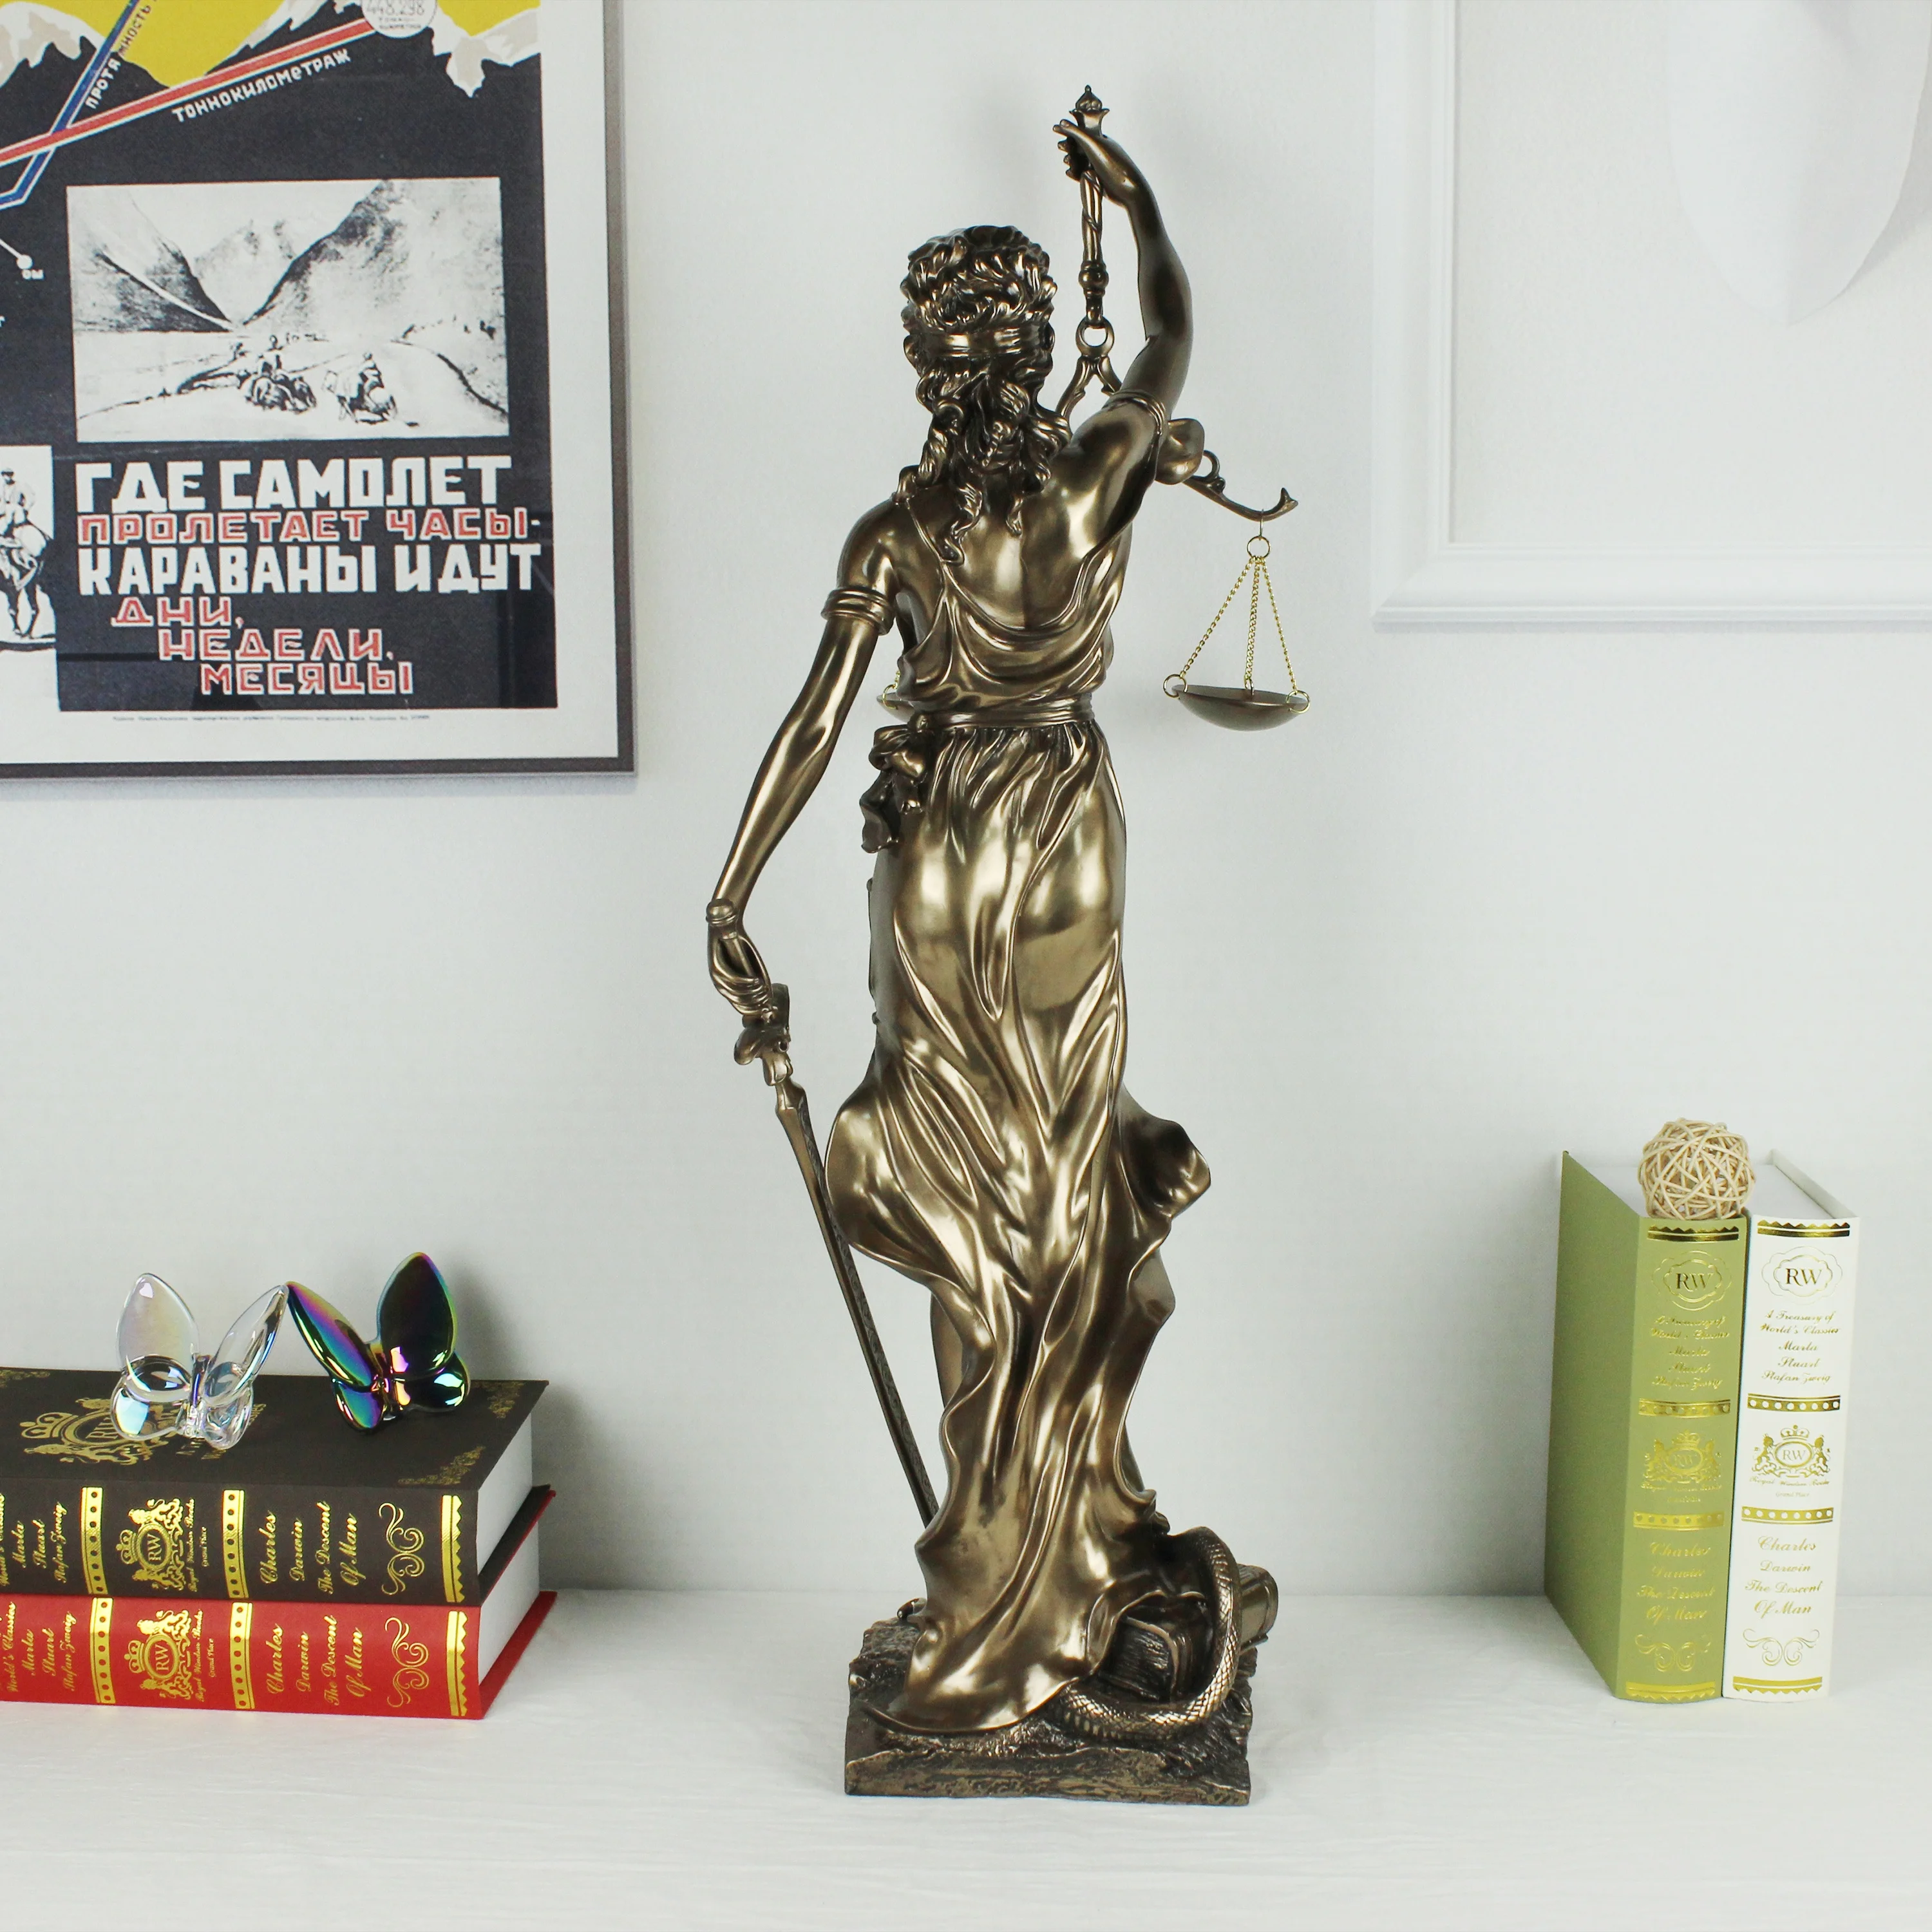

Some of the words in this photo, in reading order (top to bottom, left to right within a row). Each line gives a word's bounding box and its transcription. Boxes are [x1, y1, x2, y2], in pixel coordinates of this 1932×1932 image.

[75, 460, 205, 513] ГДЕ
[219, 455, 512, 509] САМОЛЕТ
[77, 509, 369, 545] ПРОЛЕТАЕТ
[78, 545, 377, 596] КАРАВАНЫ
[394, 543, 542, 594] ИДУТ
[111, 596, 244, 629] ДНИ,
[200, 661, 413, 696] МЕСЯЦЫ
[1676, 1273, 1714, 1292] RW
[1785, 1267, 1822, 1287] RW
[1782, 1450, 1806, 1461] RW
[147, 1533, 162, 1562] RW
[259, 1510, 278, 1584] Charles
[315, 1501, 330, 1564] Descent
[339, 1513, 357, 1564] Man
[1757, 1535, 1816, 1551] Charles
[290, 1518, 305, 1581] Darwin
[1650, 1542, 1710, 1557] Charles
[318, 1566, 334, 1595] The
[340, 1562, 366, 1586] Of
[1759, 1560, 1811, 1572] Darwin
[1745, 1579, 1770, 1592] The
[1775, 1580, 1823, 1593] Descent
[1754, 1600, 1777, 1619] Of
[1774, 1601, 1812, 1615] Man
[42, 1628, 56, 1676] Stuart
[155, 1643, 170, 1671] RW
[265, 1623, 284, 1694] Charles
[296, 1631, 311, 1692] Darwin
[321, 1615, 337, 1678] Descent
[345, 1627, 363, 1677] Man
[324, 1681, 339, 1705] The
[346, 1675, 372, 1697] Of
